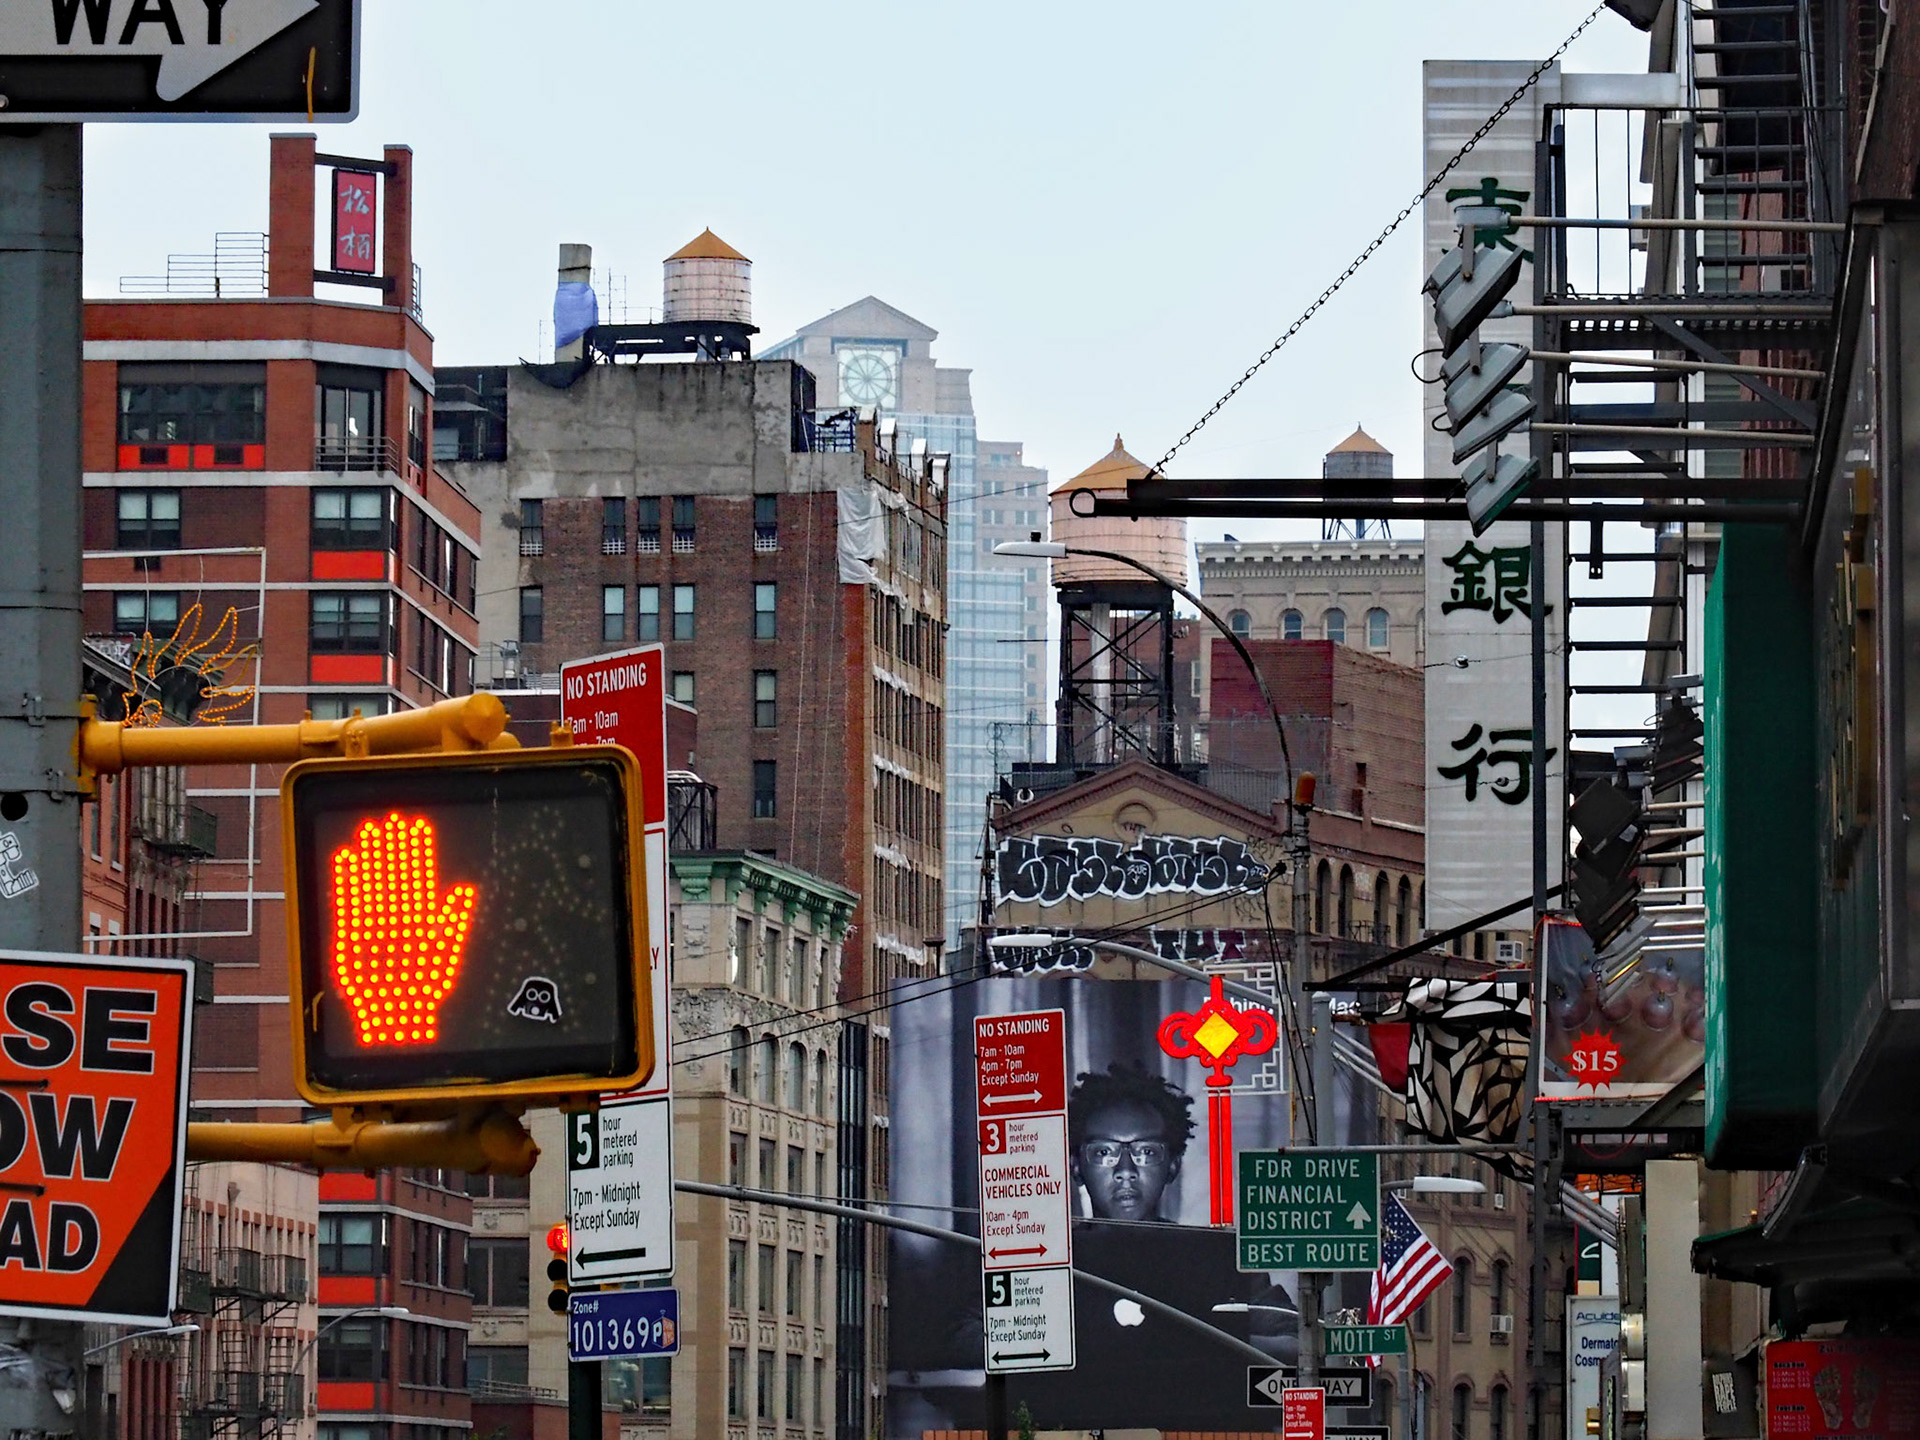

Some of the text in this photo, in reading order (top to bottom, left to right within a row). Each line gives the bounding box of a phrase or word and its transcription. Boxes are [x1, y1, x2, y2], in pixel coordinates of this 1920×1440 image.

[567, 663, 647, 700] NO STANDING
[595, 710, 619, 730] 10am
[980, 1018, 1050, 1038] NO STANDING
[980, 1046, 997, 1057] 7am
[1004, 1044, 1025, 1056] 10am
[981, 1061, 998, 1073] 4pm
[1005, 1059, 1023, 1071] 7pm
[1572, 1050, 1618, 1072] $15
[981, 1071, 1039, 1086] Except Sunday
[603, 1116, 621, 1131] hour
[1008, 1123, 1025, 1132] hour
[576, 1114, 592, 1165] 5
[603, 1130, 638, 1149] metered
[986, 1123, 1000, 1152] 3
[1009, 1132, 1039, 1142] metered
[1009, 1144, 1036, 1155] parking
[604, 1150, 634, 1170] parking
[1255, 1159, 1360, 1178] FDR DRIVE
[985, 1165, 1050, 1182] COMMERCIAL
[573, 1188, 593, 1210] 7pm
[601, 1181, 641, 1205] Midnight
[985, 1181, 1061, 1199] VEHICLES ONLY
[1247, 1185, 1347, 1204] FINANCIAL
[574, 1209, 640, 1233] Except Sunday
[986, 1211, 1005, 1222] 10am
[1012, 1210, 1029, 1222] 4pm
[1247, 1211, 1333, 1230] DISTRICT
[986, 1222, 1046, 1237] Except Sunday
[1247, 1243, 1369, 1263] BEST ROUTE
[992, 1275, 1006, 1305] 5
[1014, 1277, 1030, 1286] hour
[1014, 1286, 1044, 1296] metered
[573, 1300, 599, 1314] Zone#
[1014, 1297, 1040, 1307] parking
[990, 1317, 1006, 1329] 7pm
[1013, 1314, 1046, 1328] Midnight
[573, 1316, 650, 1352] 101369
[990, 1329, 1046, 1343] Except Sunday
[1331, 1329, 1397, 1353] MOTT ST
[1285, 1392, 1318, 1401] NO STANDING
